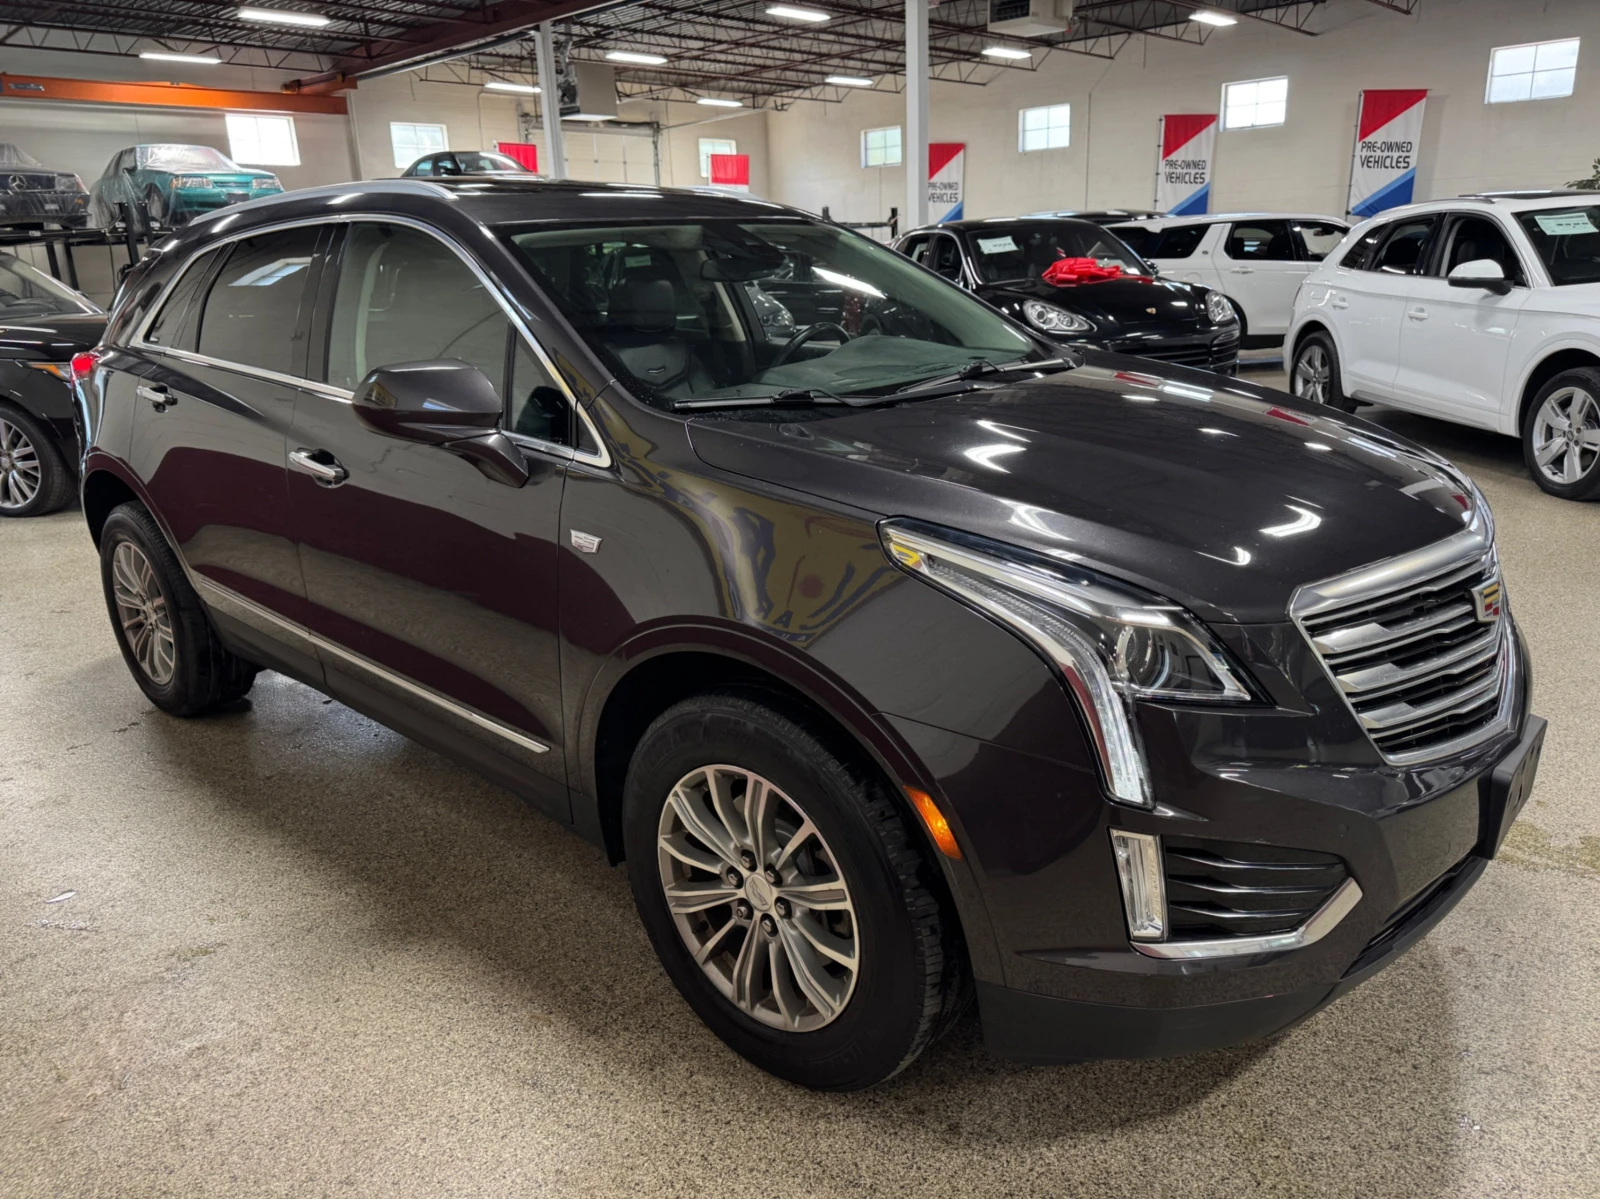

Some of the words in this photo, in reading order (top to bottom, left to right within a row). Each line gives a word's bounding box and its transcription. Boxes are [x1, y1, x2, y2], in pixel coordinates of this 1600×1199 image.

[1361, 141, 1413, 153] PRE-OWNED
[1165, 159, 1206, 170] PRE-OWNED
[1360, 154, 1411, 169] VEHICLES
[1164, 171, 1206, 184] VEHICLES
